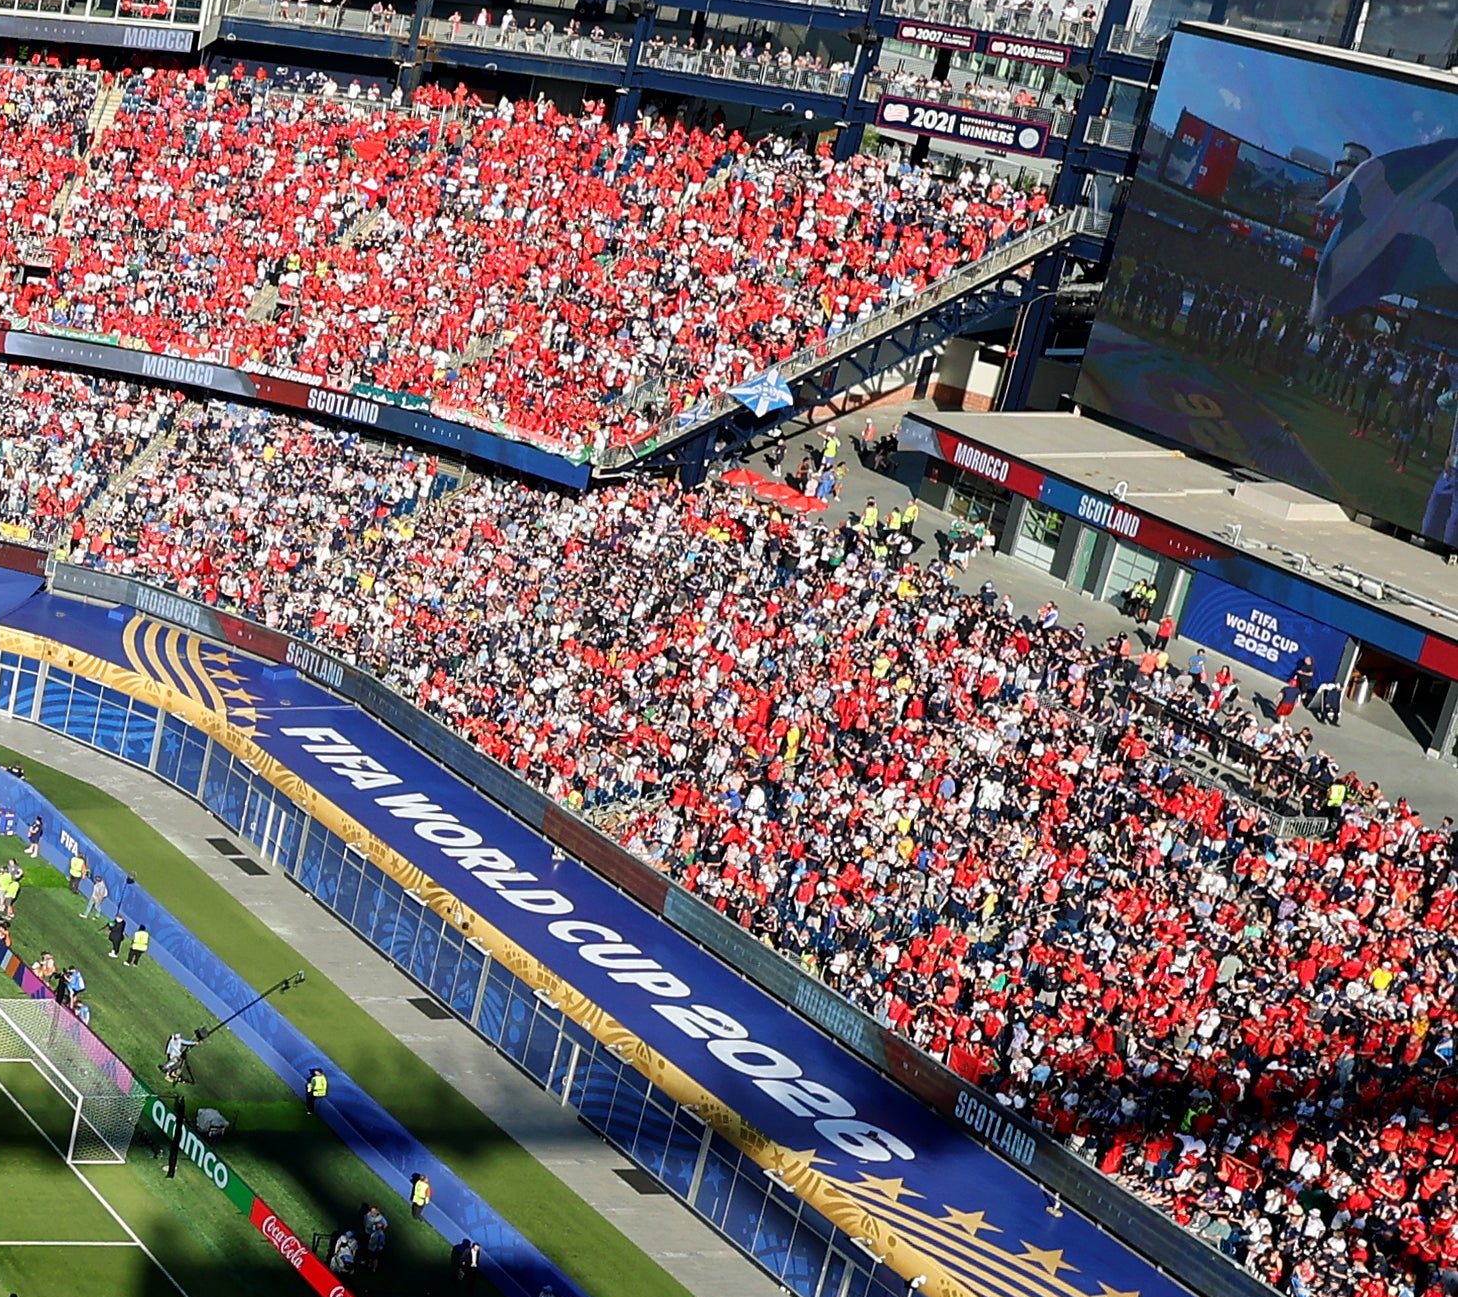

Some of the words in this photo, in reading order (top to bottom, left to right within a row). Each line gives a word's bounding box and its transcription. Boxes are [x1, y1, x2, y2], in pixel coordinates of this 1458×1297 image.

[123, 27, 194, 53] MOROCCO
[915, 29, 942, 43] 2007
[1006, 43, 1035, 58] 2008
[911, 107, 957, 134] 2021
[959, 123, 1015, 145] WINNERS
[141, 354, 215, 386] MOROCCO
[307, 388, 380, 426] SCOTLAND
[953, 442, 1010, 483] MOROCCO
[1077, 493, 1141, 539] SCOTLAND
[1225, 612, 1269, 644] WORLD
[1270, 635, 1300, 655] CUP
[1250, 608, 1279, 631] FIFA
[135, 587, 200, 628] MOROCCO
[285, 641, 344, 689] SCOTLAND
[1233, 633, 1279, 664] 2026
[60, 830, 79, 855] FIFA
[279, 726, 404, 791] FIFA
[374, 792, 577, 916] WORLD
[547, 920, 692, 999] CUP
[650, 1003, 916, 1163] 2026
[794, 979, 865, 1045] MOROCCO
[954, 1090, 1038, 1167] SCOTLAND
